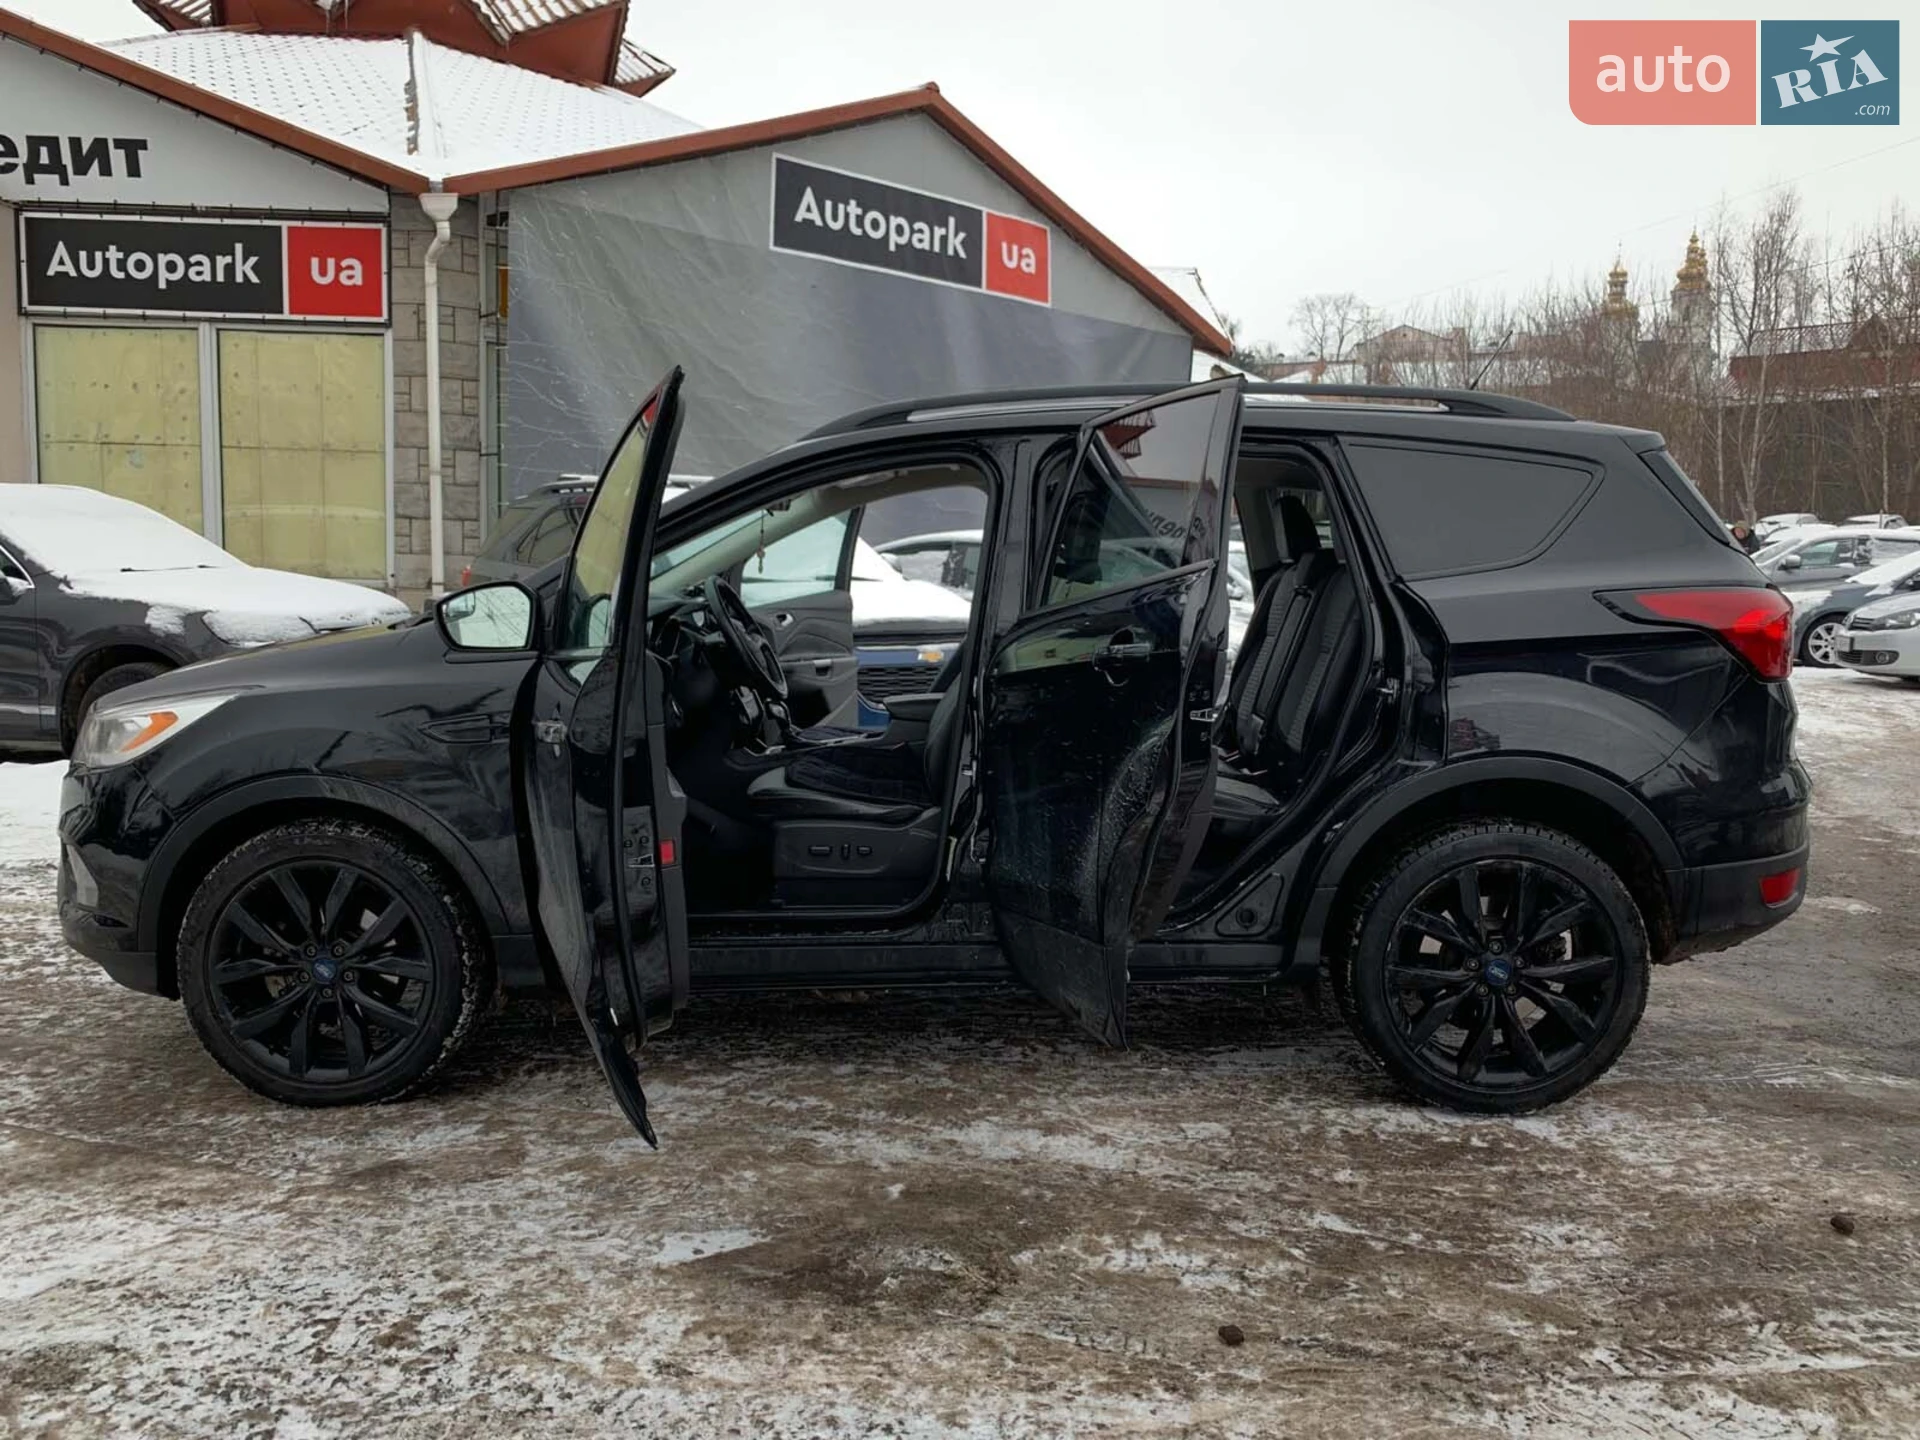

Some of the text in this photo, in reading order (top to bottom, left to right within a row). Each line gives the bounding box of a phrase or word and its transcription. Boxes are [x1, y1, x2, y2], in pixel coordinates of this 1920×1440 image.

[46, 240, 363, 289] Autopark ua
[794, 185, 1037, 275] Autopark ua
